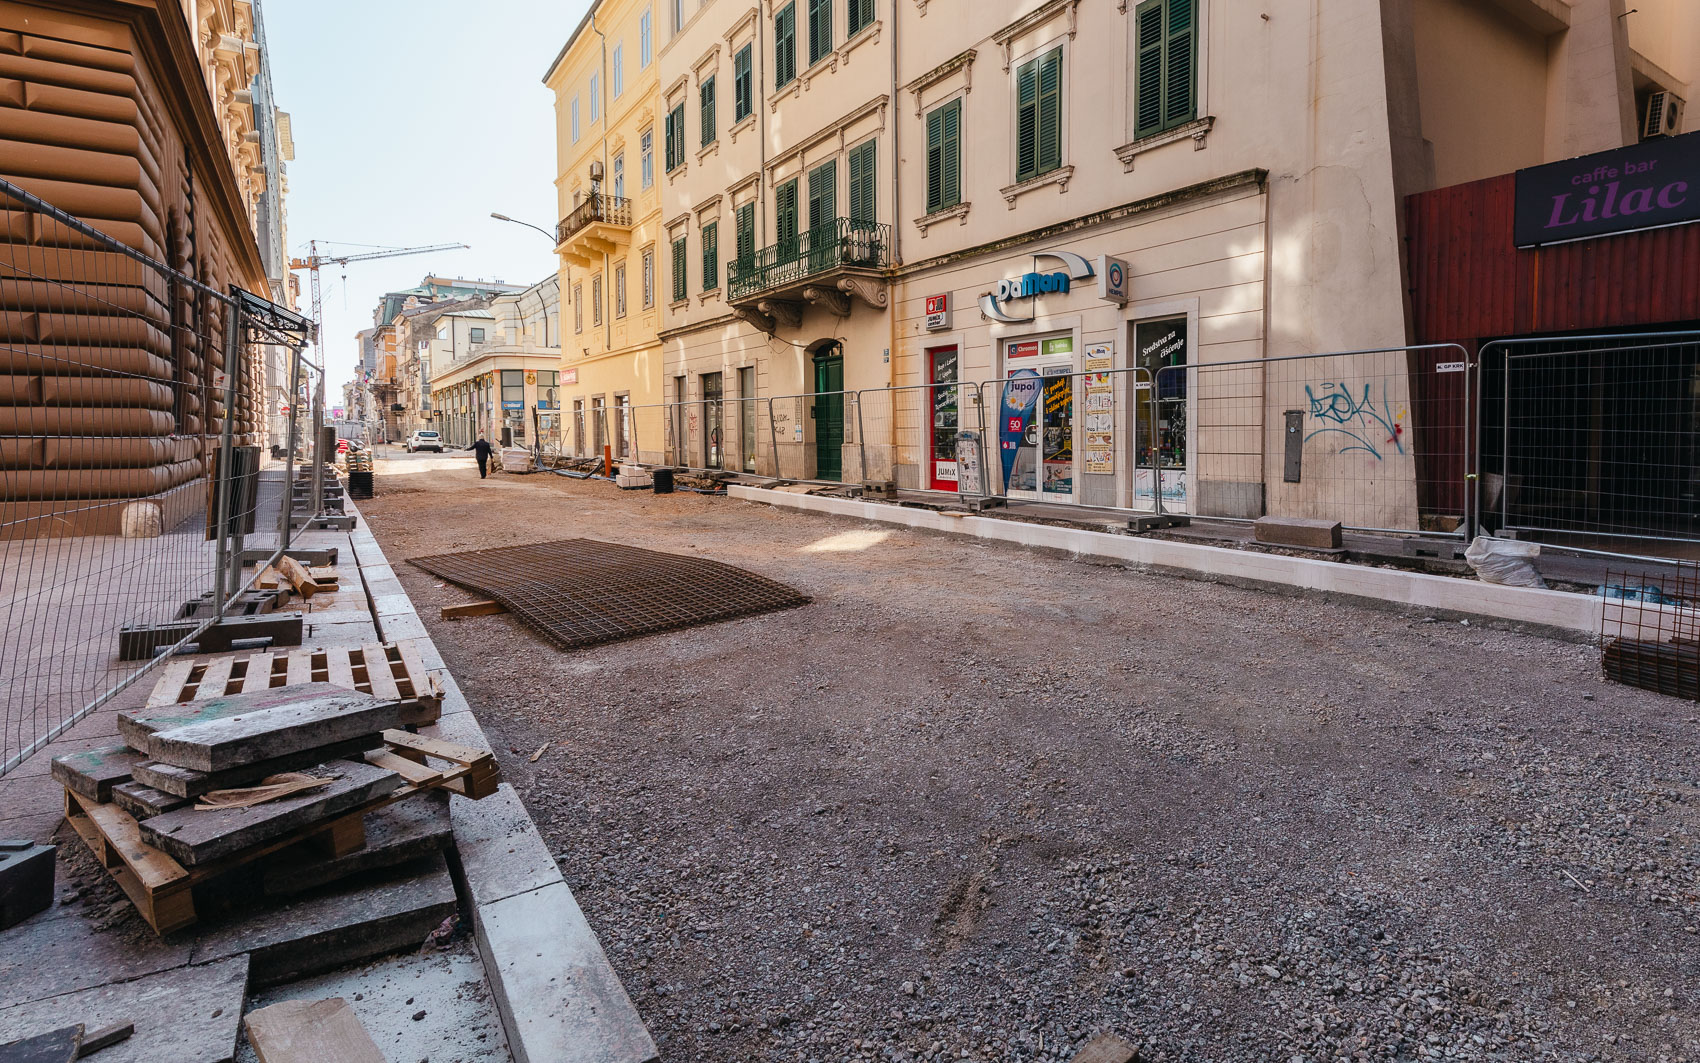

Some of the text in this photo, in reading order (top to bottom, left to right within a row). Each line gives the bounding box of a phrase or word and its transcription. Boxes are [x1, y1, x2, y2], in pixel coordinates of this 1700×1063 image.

[1571, 160, 1657, 186] caffe bar
[1543, 181, 1688, 229] Lilac
[1109, 288, 1124, 298] HEMPEL
[1142, 330, 1176, 357] Sredstva za
[1160, 338, 1184, 358] čišćenje
[1011, 381, 1036, 392] jupol
[1010, 420, 1021, 429] 50
